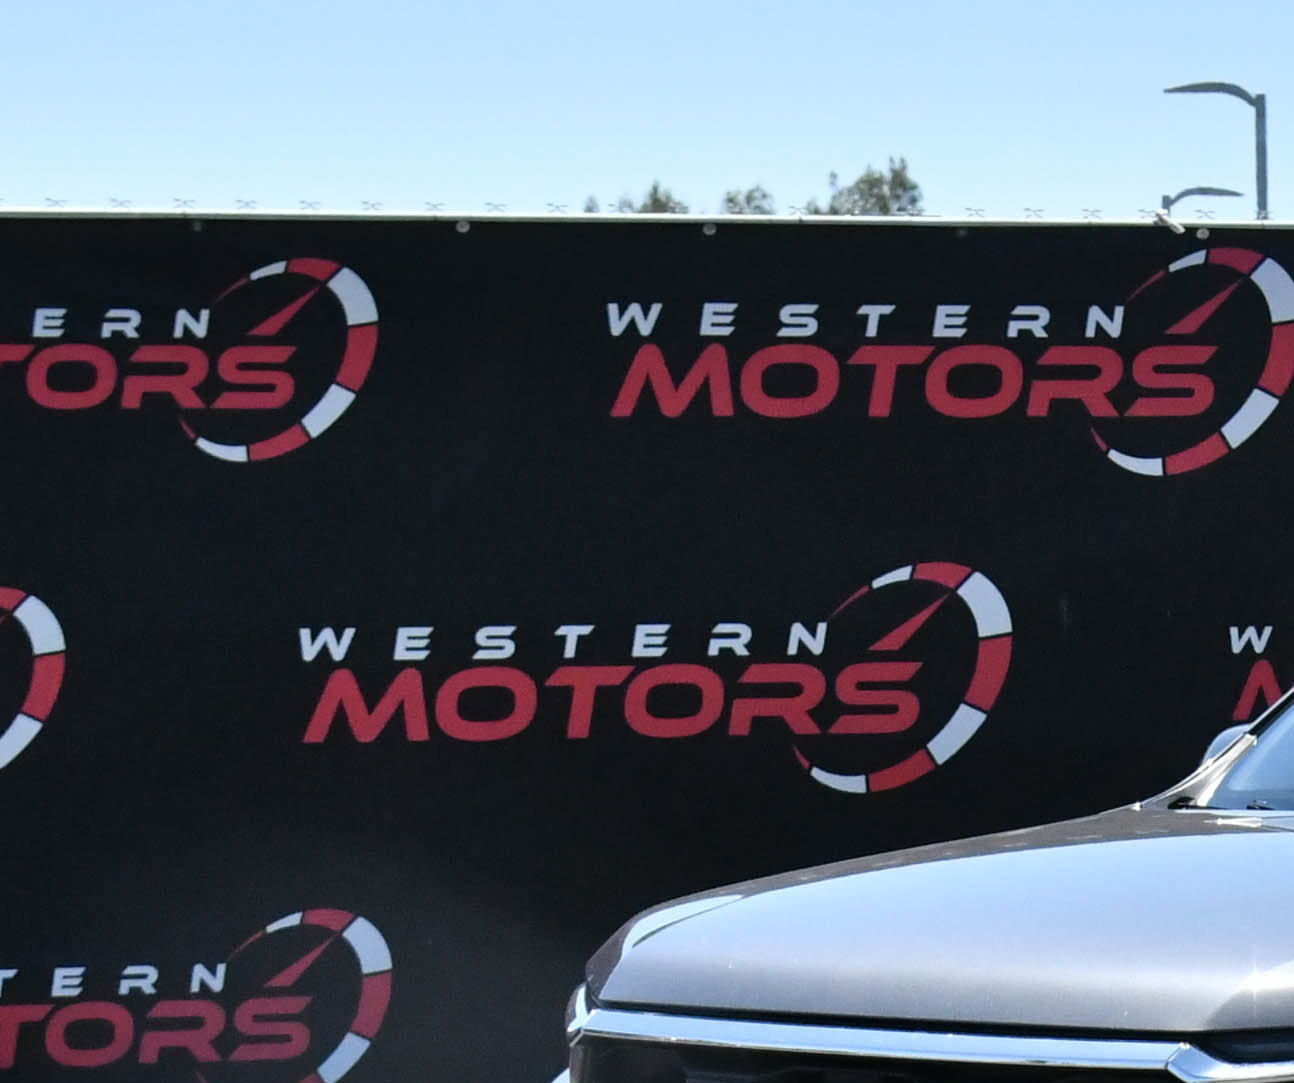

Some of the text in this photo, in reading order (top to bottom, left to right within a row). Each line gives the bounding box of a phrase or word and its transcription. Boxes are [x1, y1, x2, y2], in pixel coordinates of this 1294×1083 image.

[32, 308, 210, 338] ERN
[608, 302, 1124, 338] WESTERN
[611, 343, 1217, 419] MOTORS
[299, 622, 827, 662] WESTERN
[303, 662, 921, 744] MOTORS
